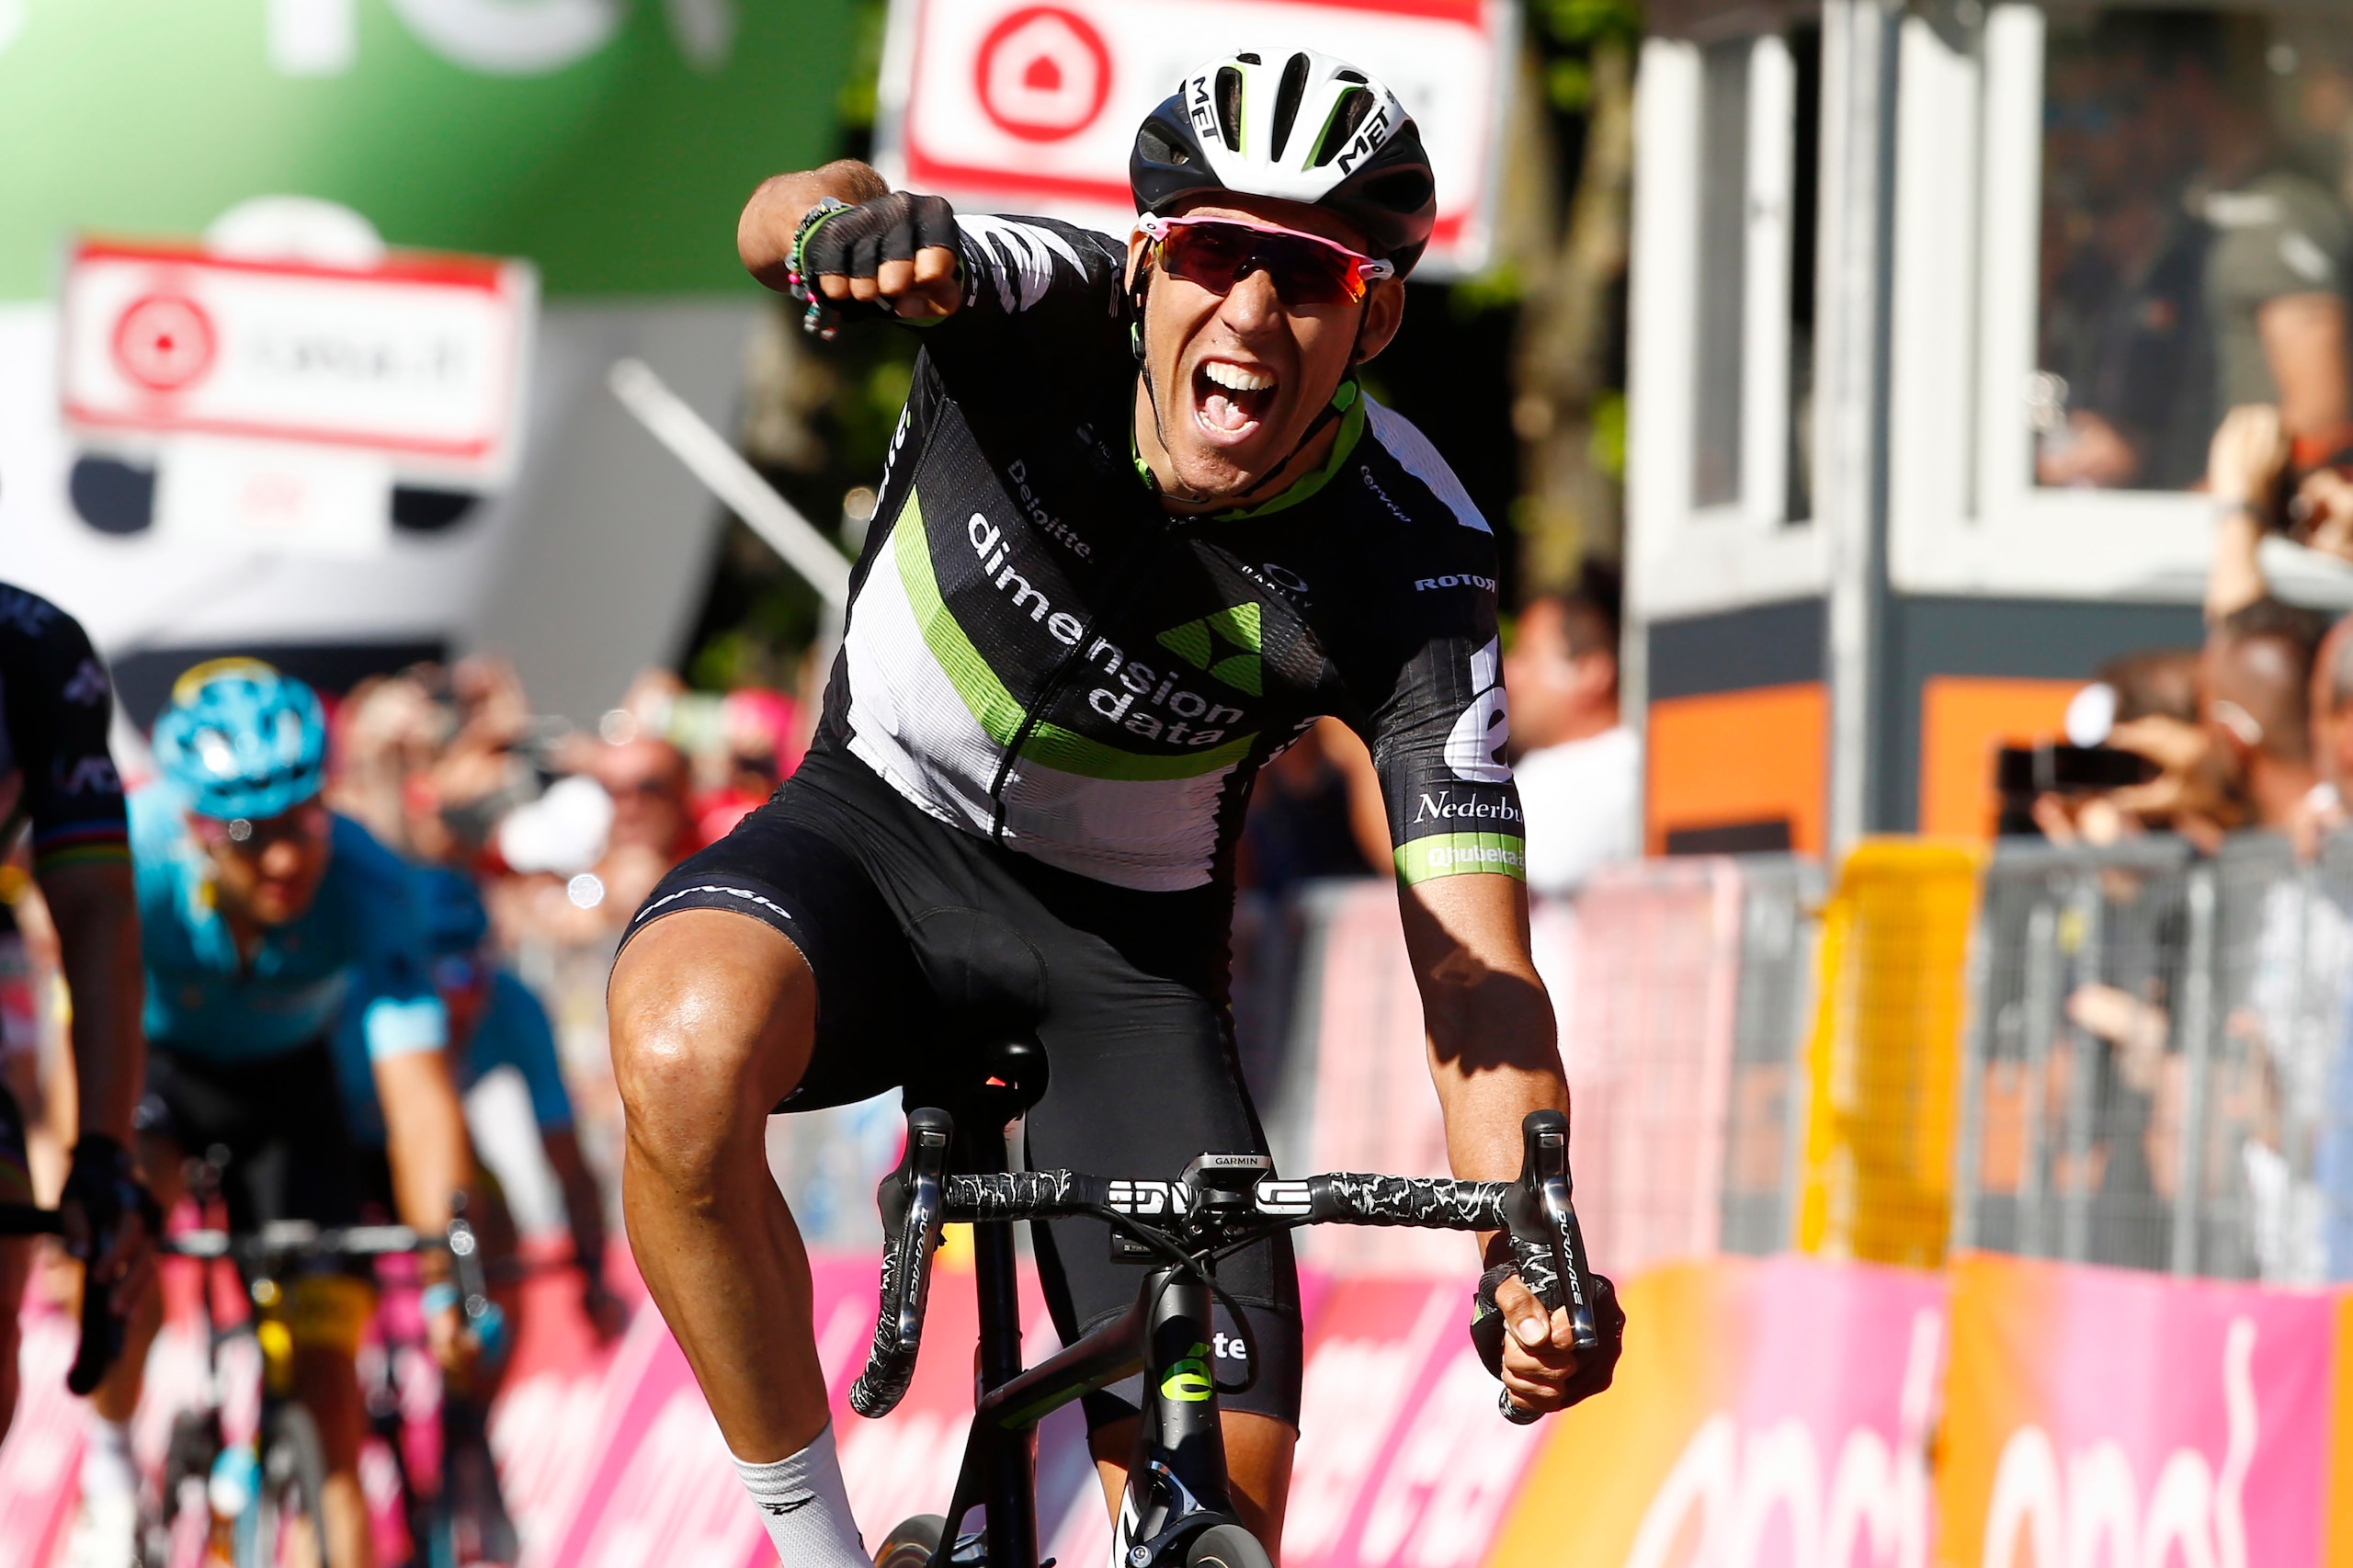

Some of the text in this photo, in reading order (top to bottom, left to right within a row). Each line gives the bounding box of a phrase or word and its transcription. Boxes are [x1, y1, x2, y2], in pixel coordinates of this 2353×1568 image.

[1192, 76, 1222, 143] MET
[1337, 105, 1390, 176] MET
[967, 511, 1245, 726] dimension
[1414, 574, 1495, 594] ROTOR
[1088, 687, 1226, 745] data
[1214, 1156, 1259, 1165] GARMIN
[908, 1206, 930, 1307] DURA-ACE
[1557, 1209, 1584, 1306] DURA-ACE
